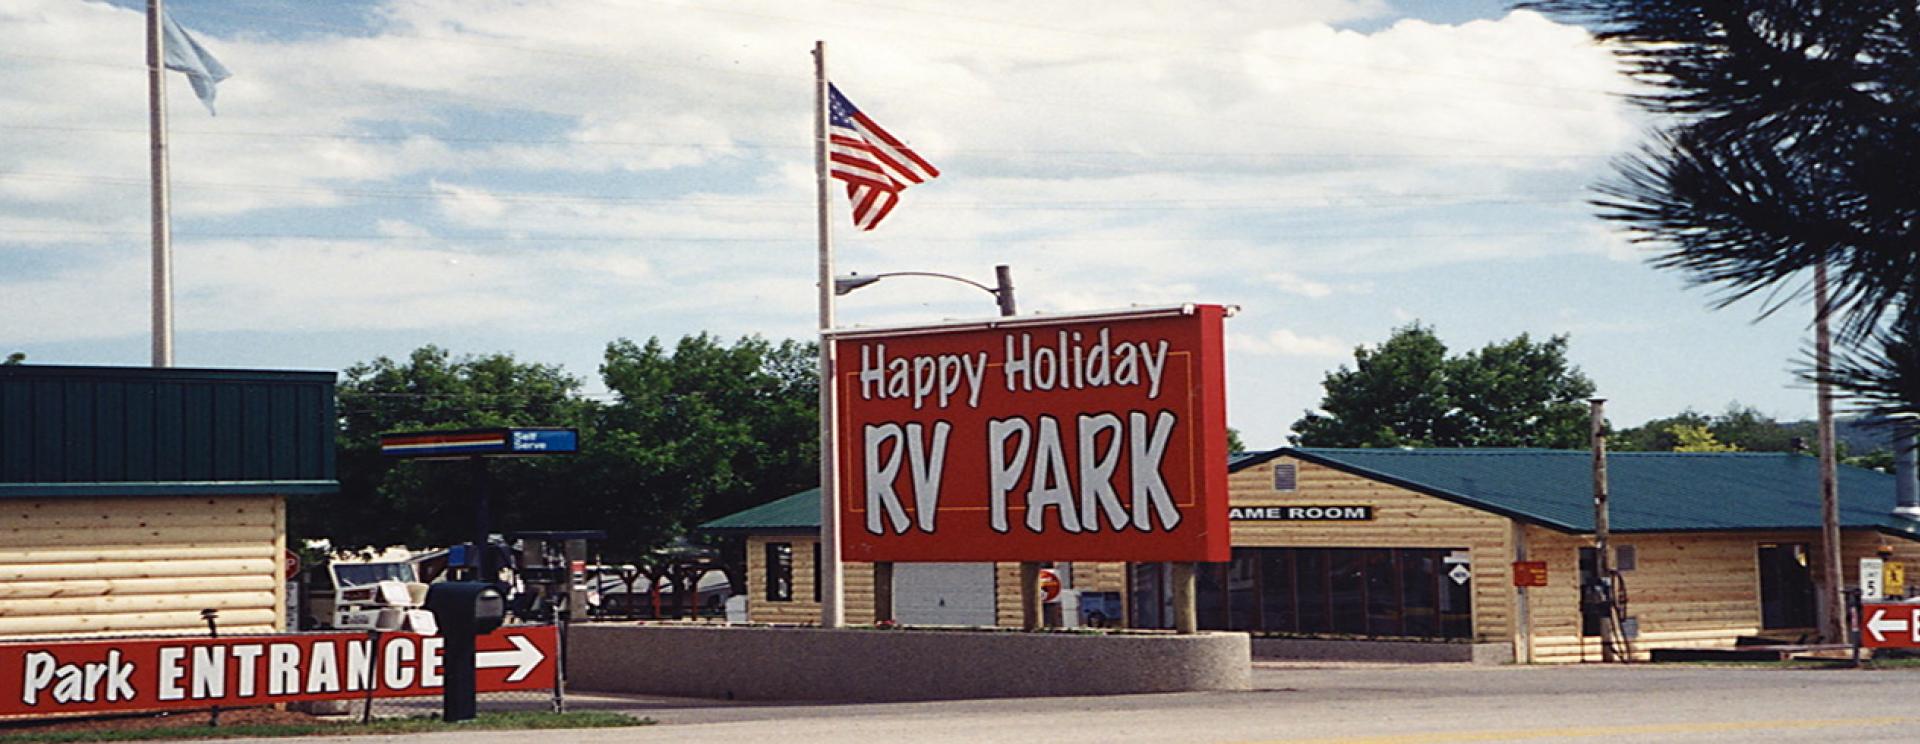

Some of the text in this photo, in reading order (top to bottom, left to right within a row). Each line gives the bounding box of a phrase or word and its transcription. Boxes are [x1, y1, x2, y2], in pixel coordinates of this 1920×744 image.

[859, 327, 1169, 408] Happy Holiday
[864, 411, 1181, 535] RV PARK
[1229, 507, 1366, 519] AME ROOM
[23, 638, 444, 705] Park ENTRANCE
